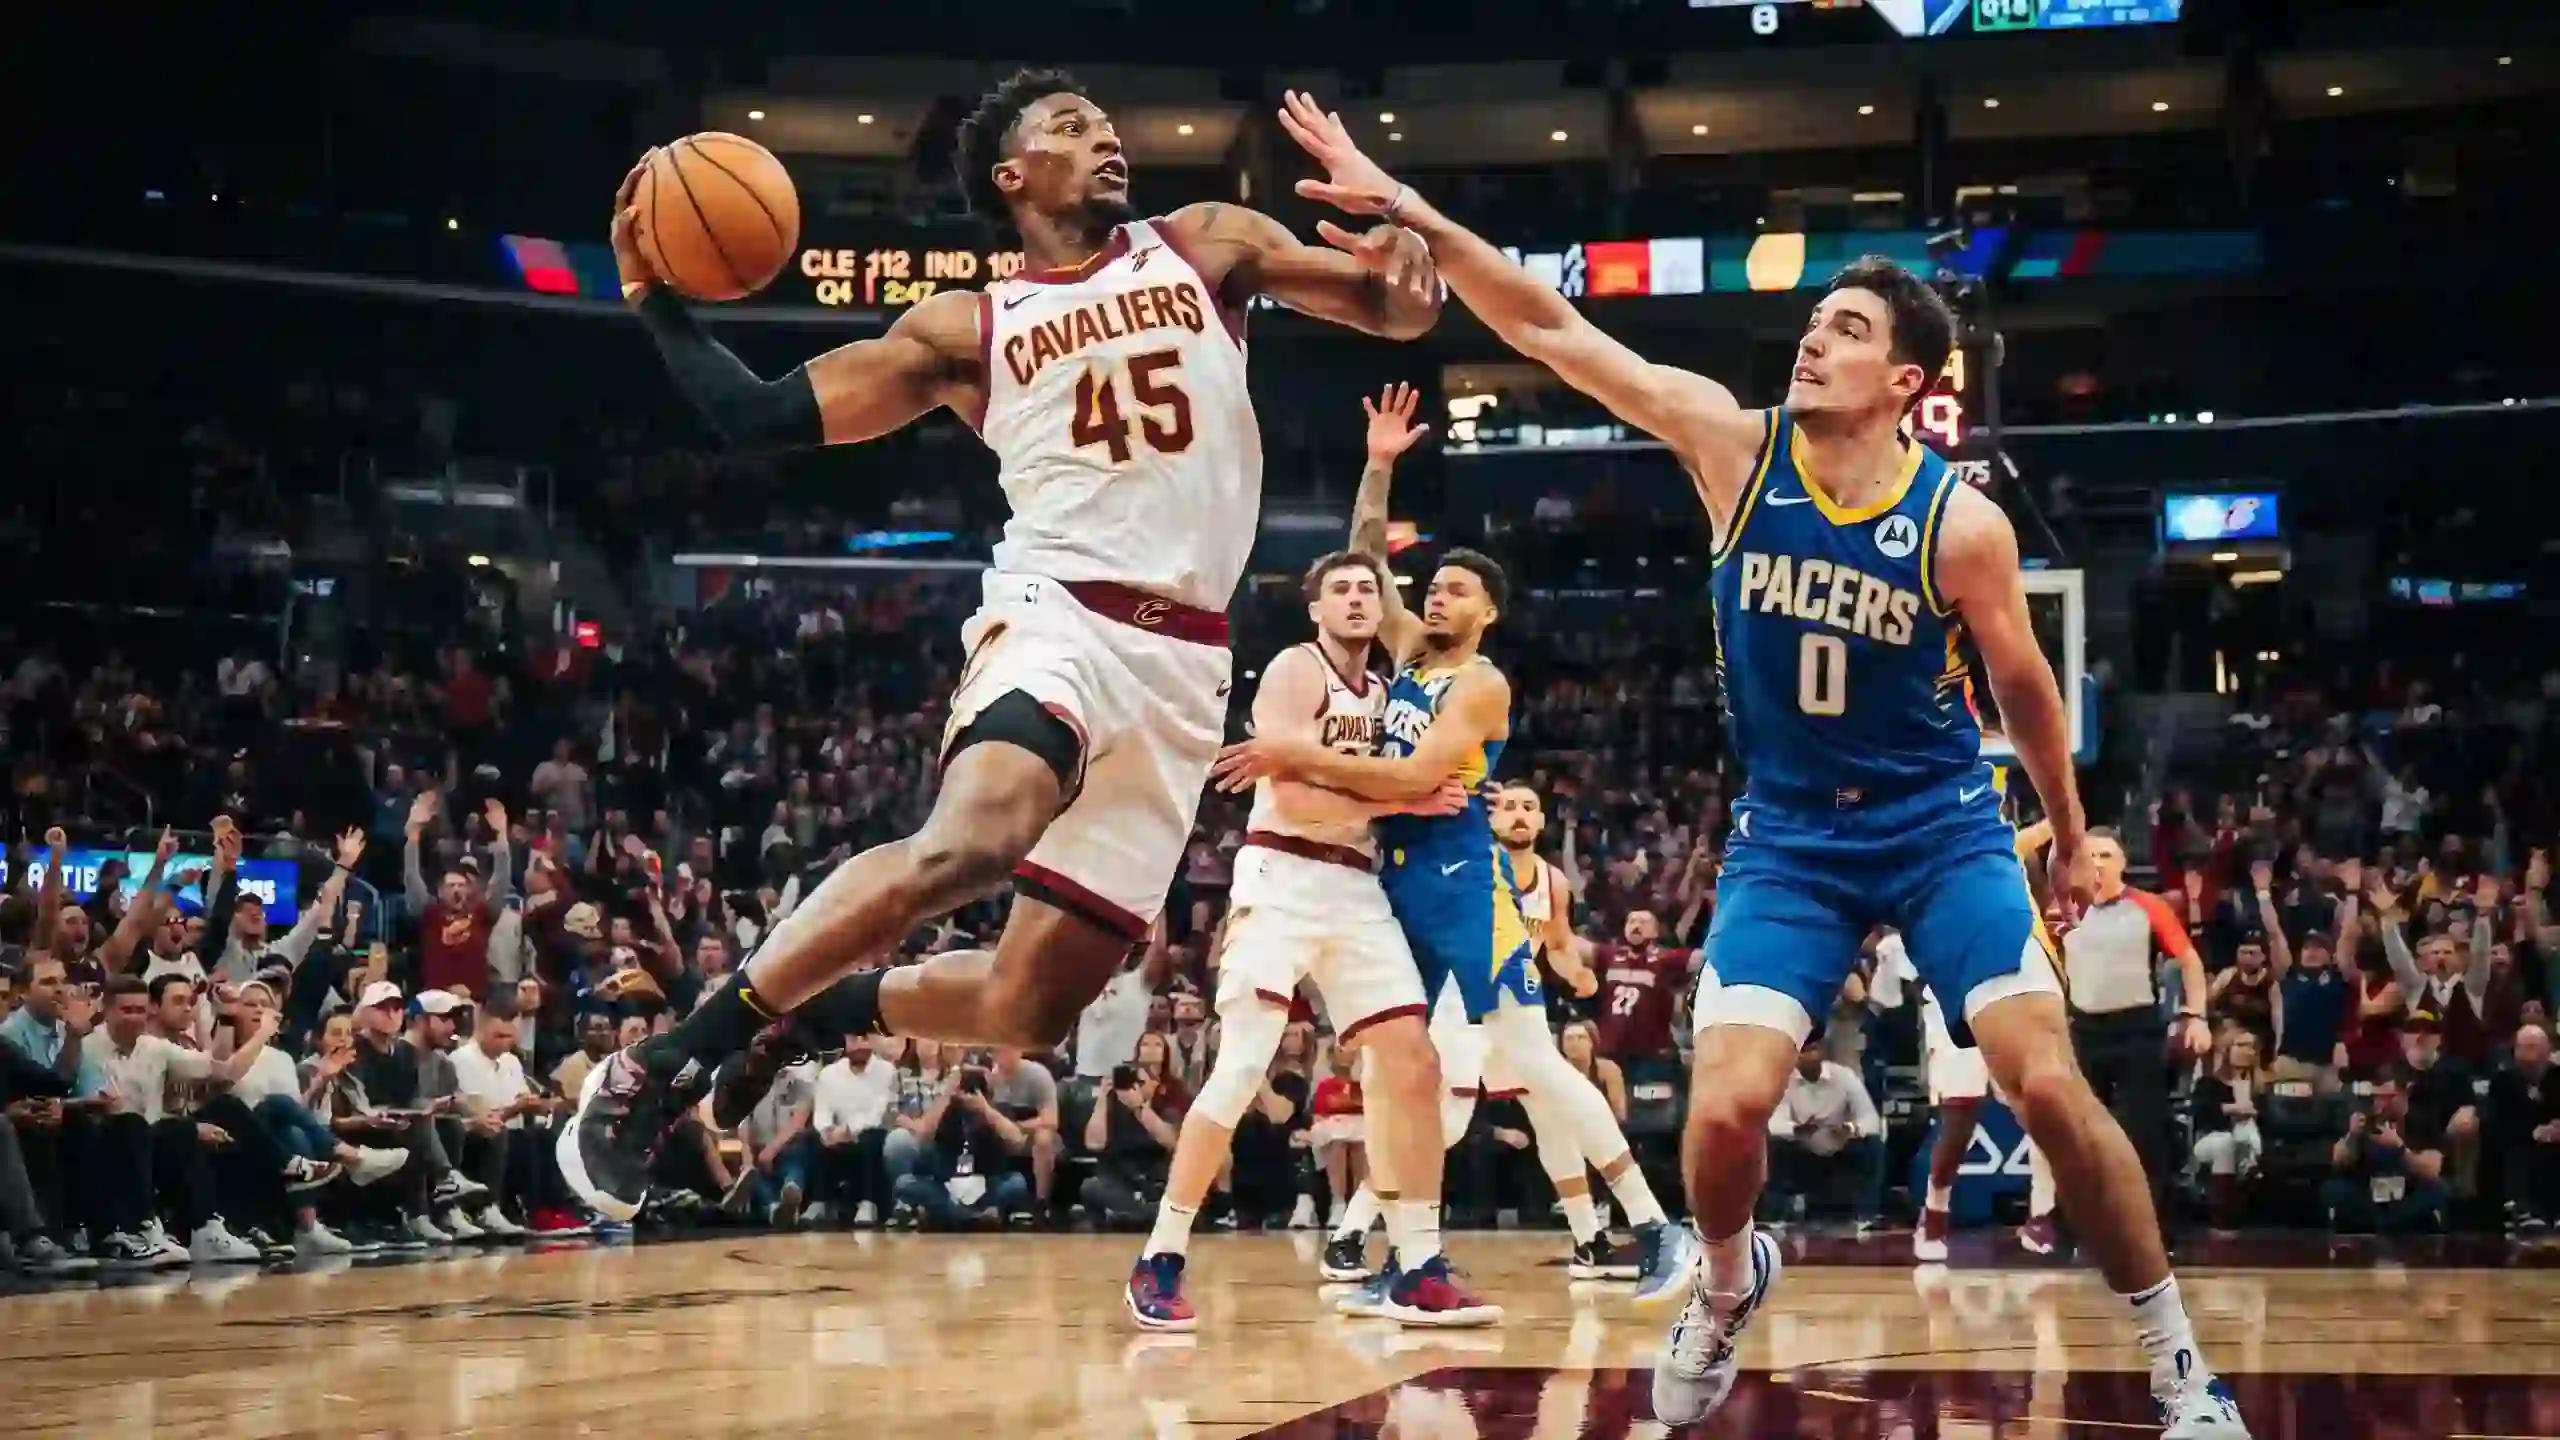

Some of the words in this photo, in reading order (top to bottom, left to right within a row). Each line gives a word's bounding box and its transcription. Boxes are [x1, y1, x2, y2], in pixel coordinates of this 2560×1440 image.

[801, 249, 856, 277] CLE
[865, 249, 911, 279] 112
[925, 251, 977, 279] IND
[816, 279, 853, 306] Q4
[1004, 283, 1205, 386] CAVALIERS
[1071, 348, 1194, 463] 45
[1740, 552, 1920, 645] PACERS
[1799, 632, 1847, 717] 0
